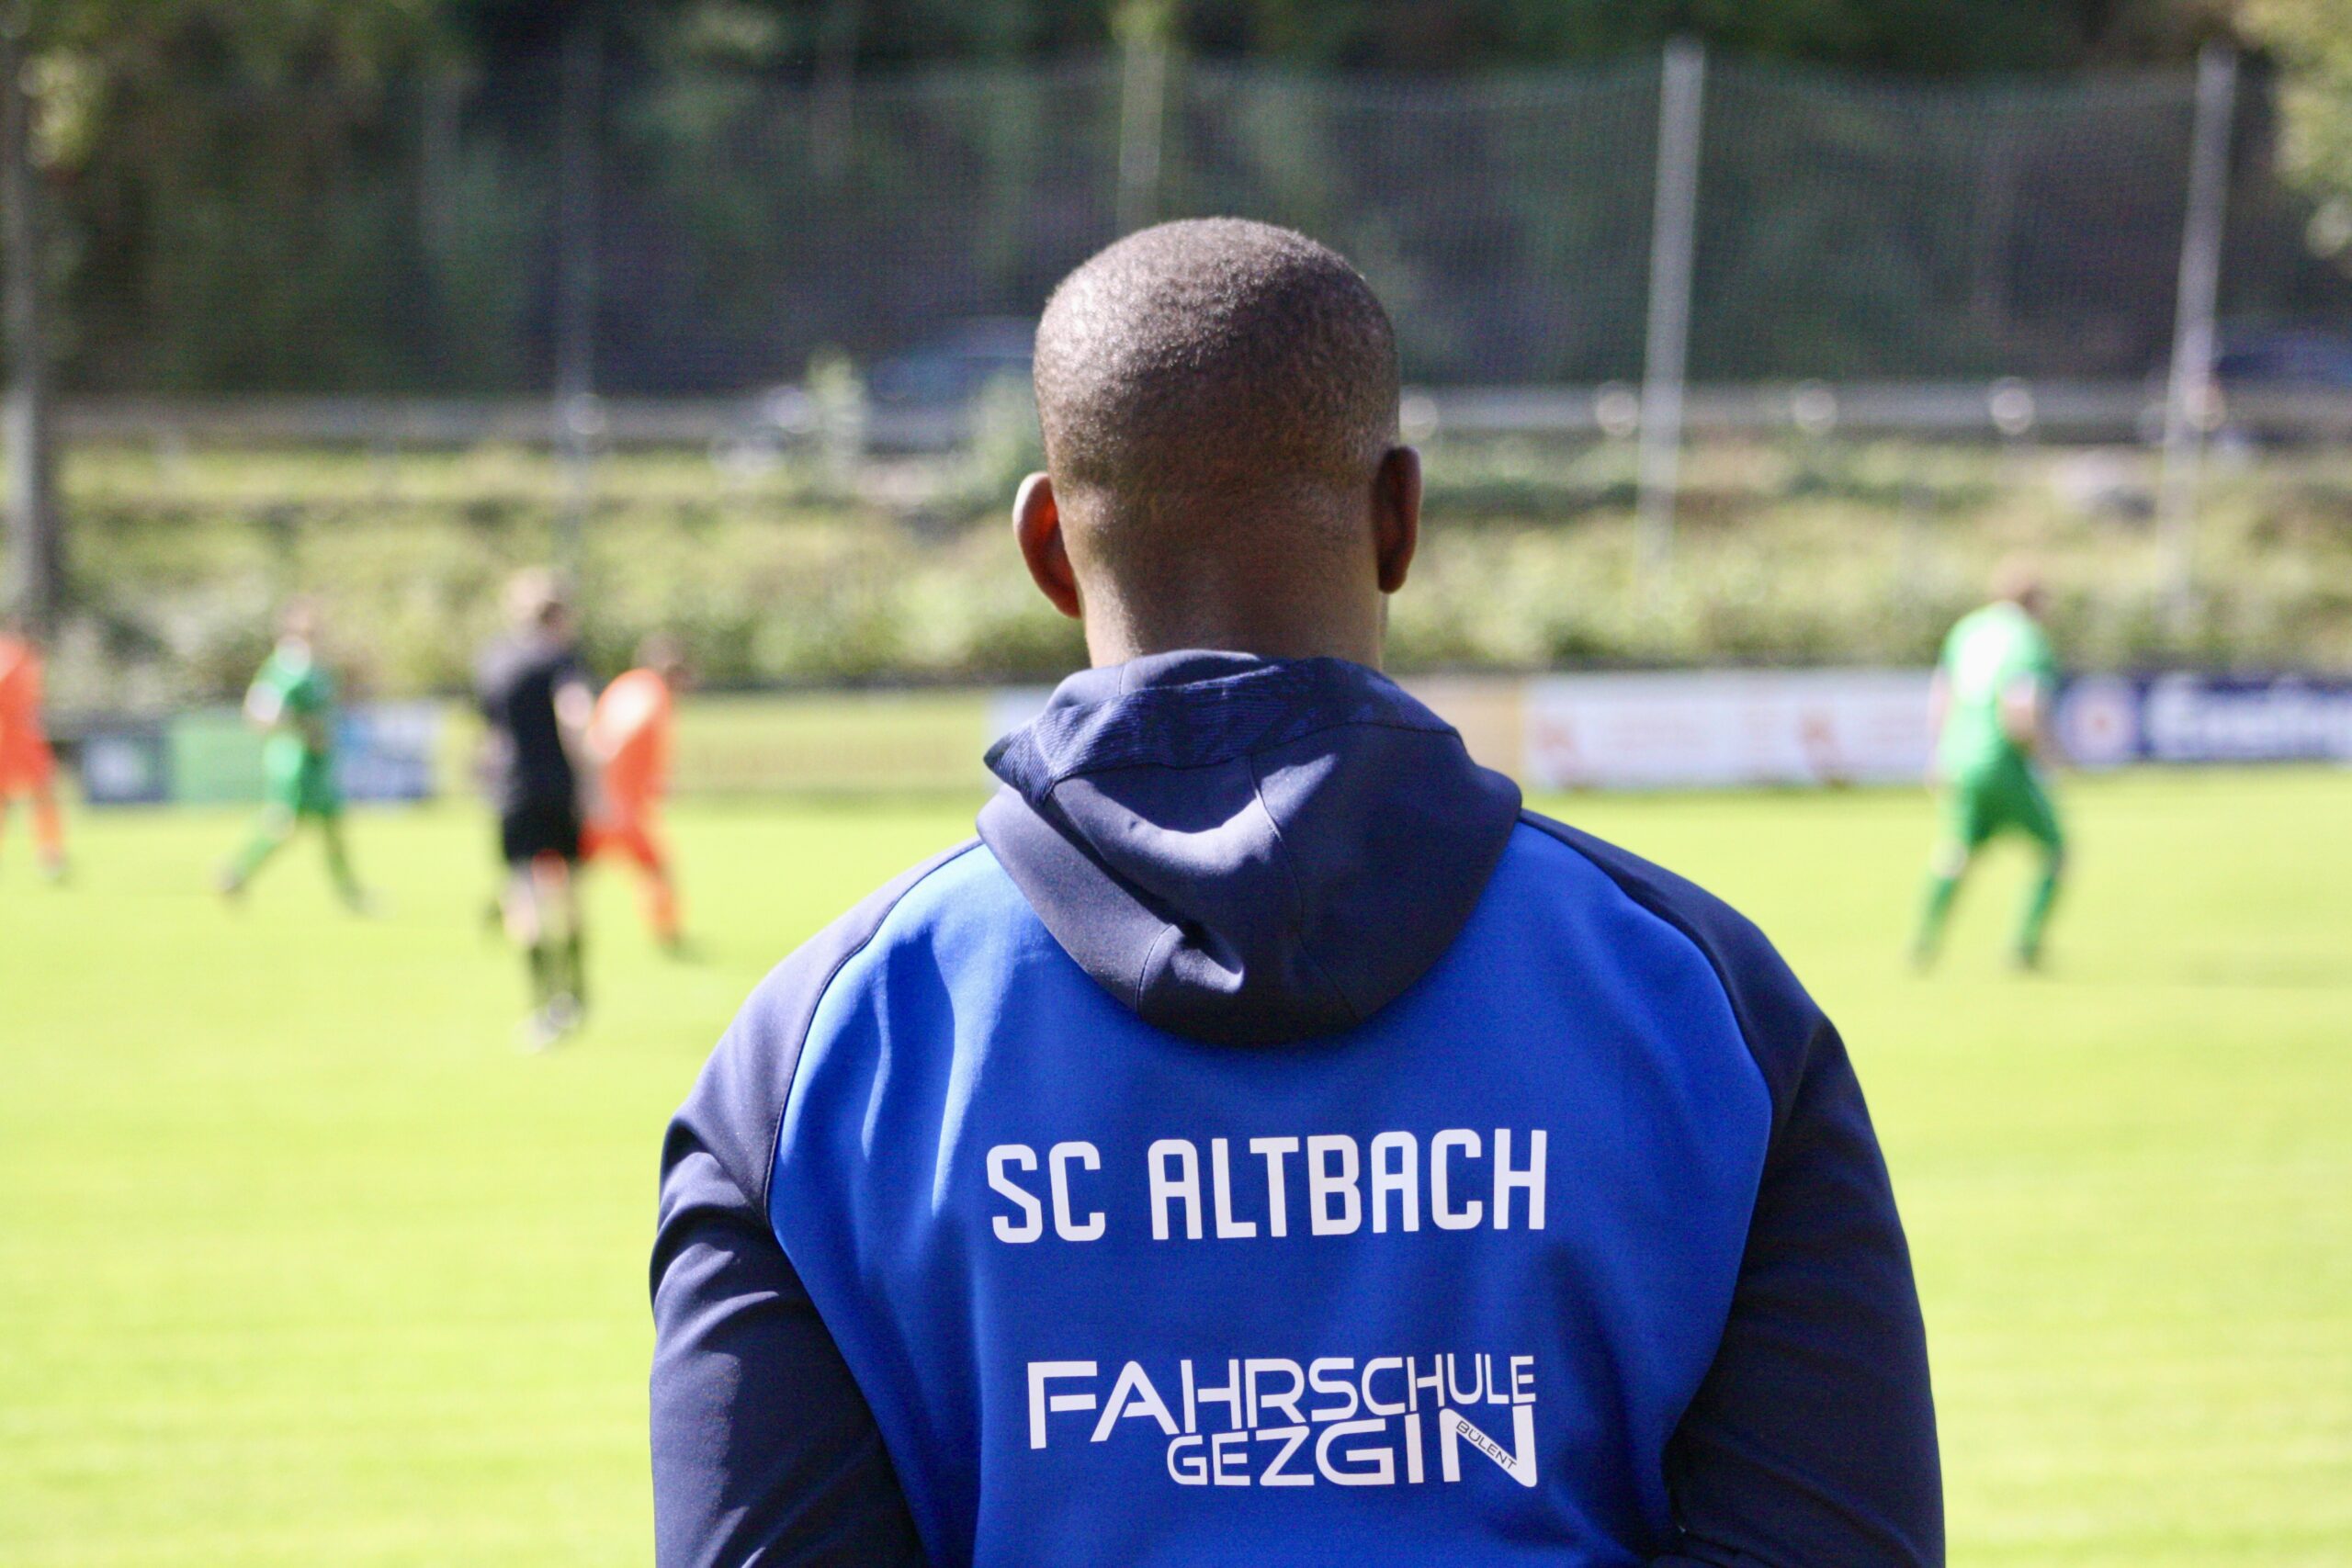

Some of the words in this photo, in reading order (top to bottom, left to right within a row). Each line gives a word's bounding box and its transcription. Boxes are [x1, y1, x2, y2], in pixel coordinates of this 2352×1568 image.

[986, 1141, 1106, 1244] SC
[1148, 1128, 1547, 1240] ALTBACH
[1027, 1353, 1537, 1450] FAHRSCHULE
[1167, 1404, 1538, 1488] GEZGIN
[1455, 1420, 1518, 1470] BÜLENT
